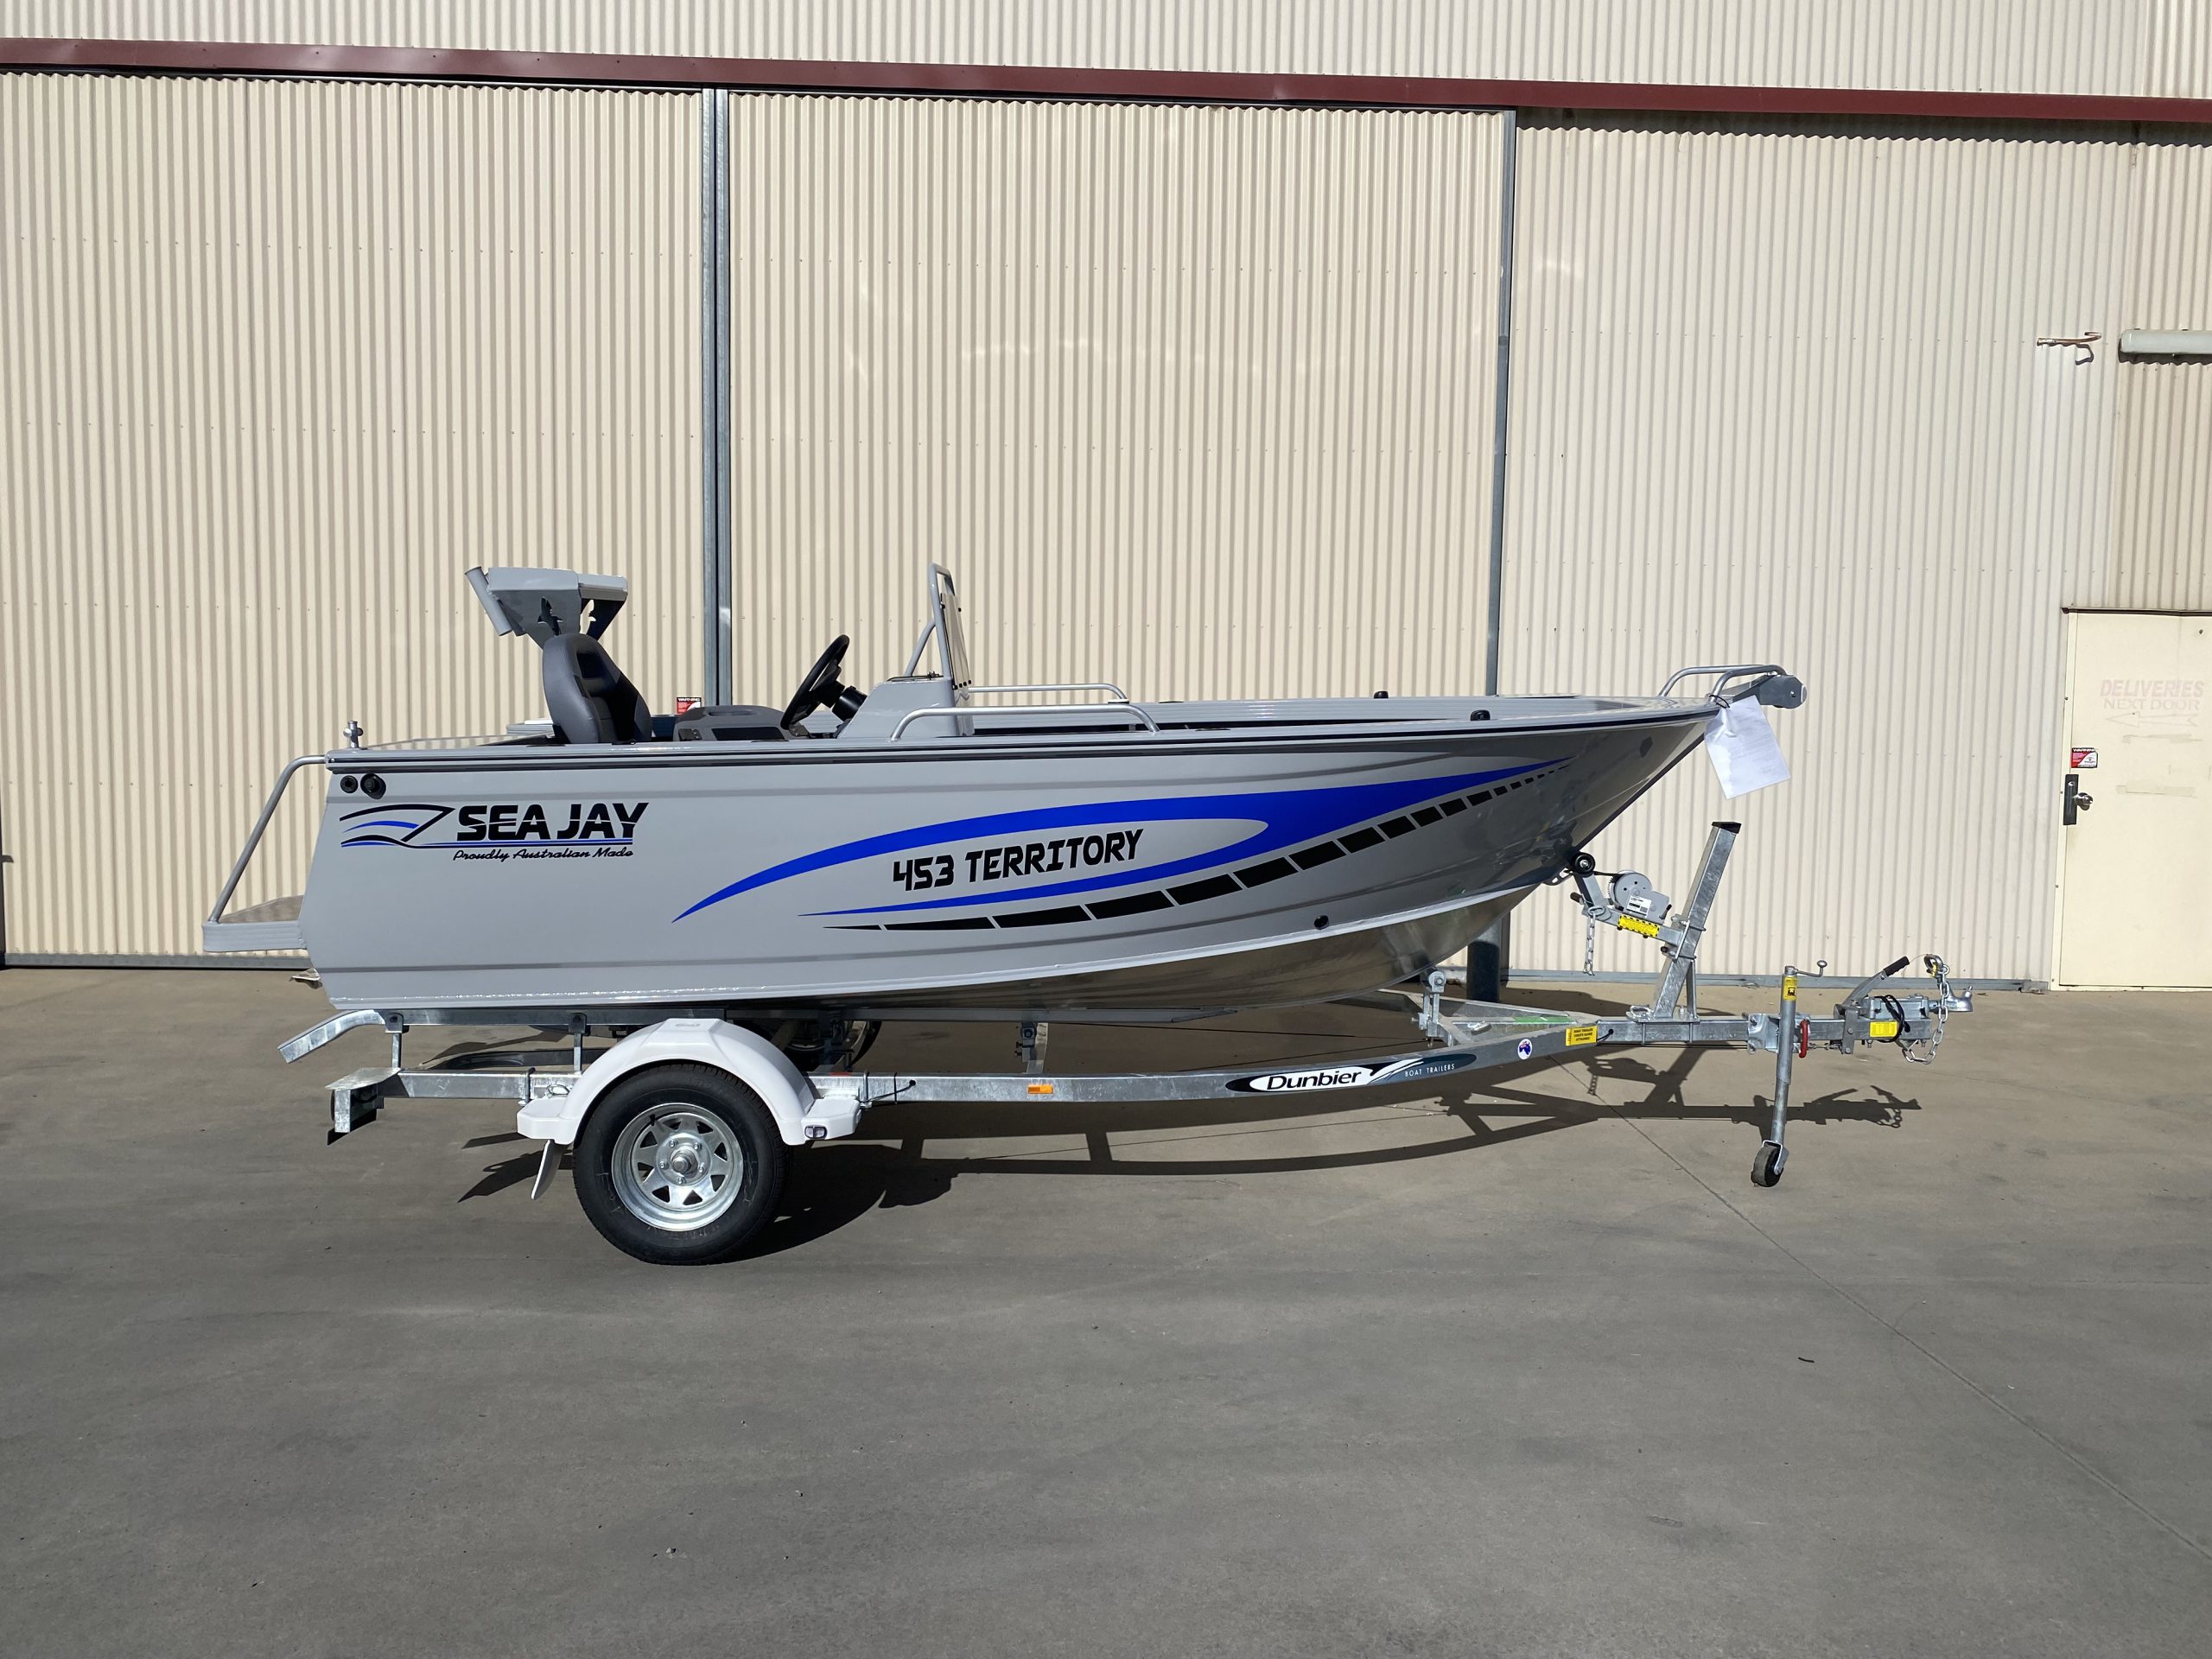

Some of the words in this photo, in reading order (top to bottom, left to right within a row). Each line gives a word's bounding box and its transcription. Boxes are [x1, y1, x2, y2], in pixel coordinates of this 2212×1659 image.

[2101, 679, 2205, 698] DELIVERIES
[2103, 698, 2146, 710] NEXT
[2151, 698, 2200, 711] DOOR
[456, 804, 551, 842] SEA
[556, 802, 650, 840] JAY
[453, 849, 510, 862] Proudly
[512, 847, 590, 860] Australian
[592, 846, 634, 858] Made
[893, 854, 955, 892] 453
[964, 828, 1144, 883] TERRITORY
[1404, 1068, 1422, 1077] BOAT
[1427, 1063, 1455, 1074] TRAILERS
[1267, 1070, 1362, 1090] Dunbier
